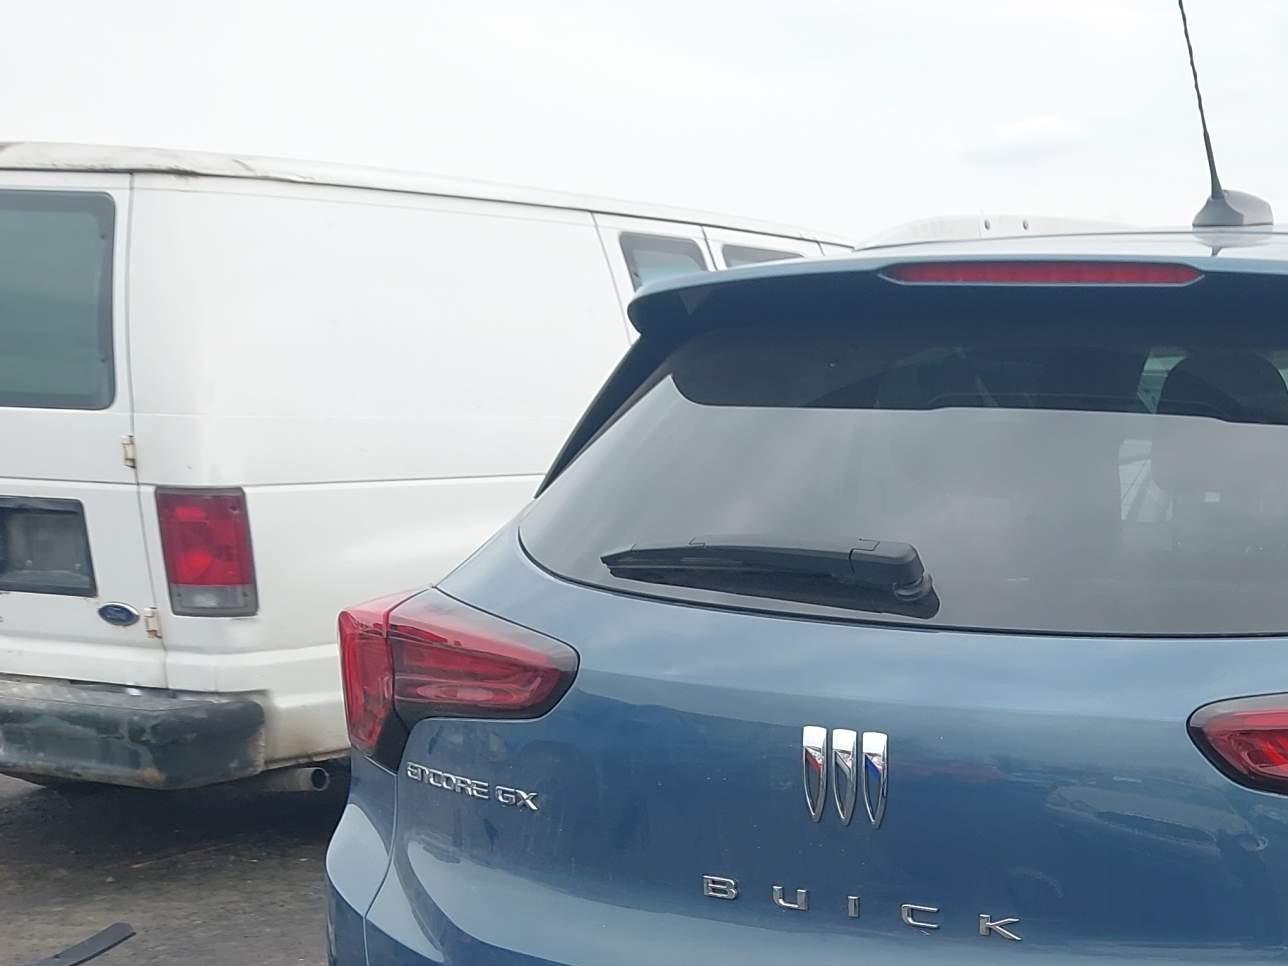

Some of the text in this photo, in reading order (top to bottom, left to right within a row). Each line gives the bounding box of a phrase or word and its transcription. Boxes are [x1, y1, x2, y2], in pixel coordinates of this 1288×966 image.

[407, 761, 538, 811] ENCORE GX
[702, 874, 1022, 941] BUICK
